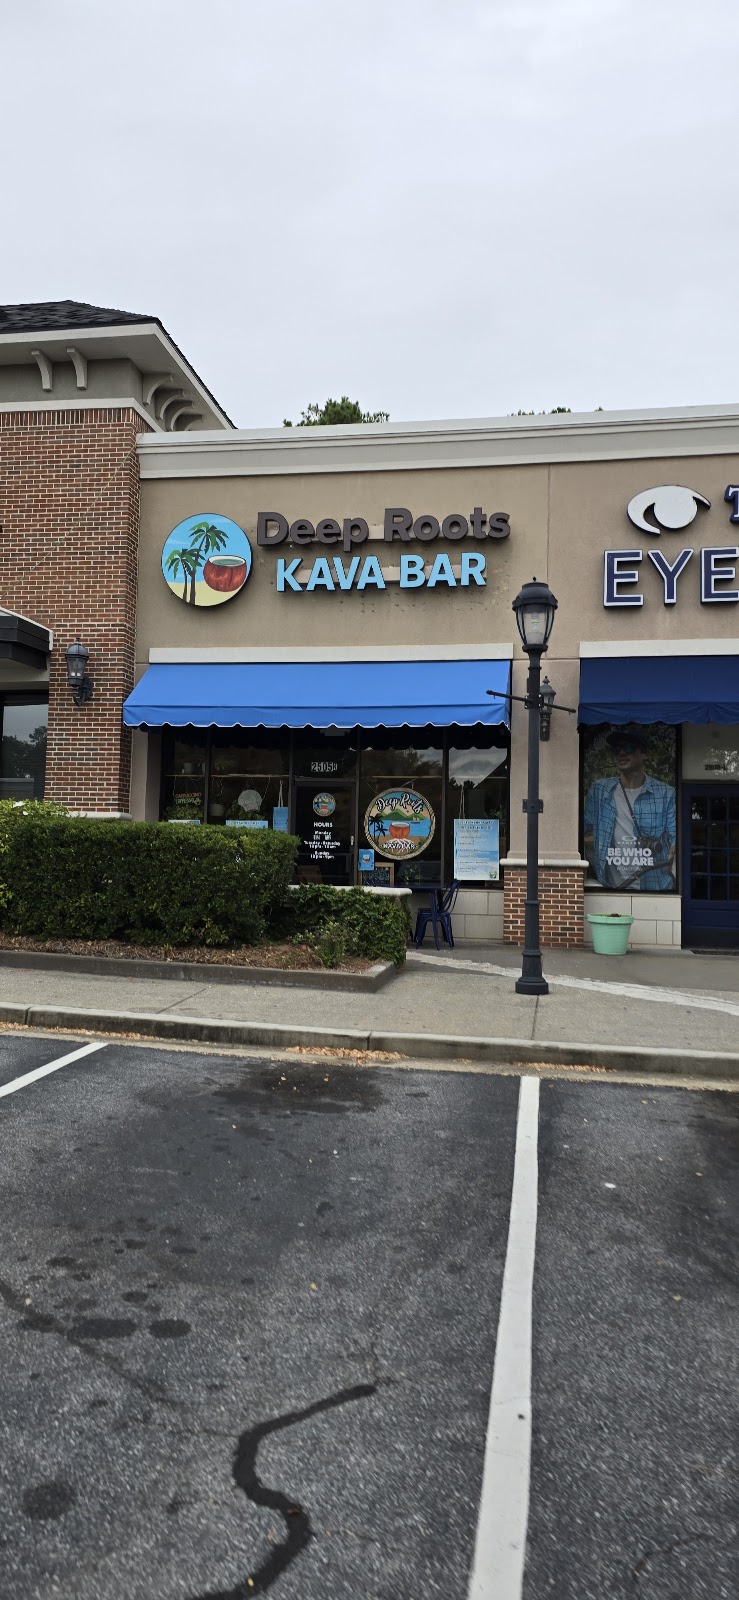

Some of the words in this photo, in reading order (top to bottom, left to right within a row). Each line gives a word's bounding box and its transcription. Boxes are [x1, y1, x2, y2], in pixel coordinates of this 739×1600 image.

[257, 512, 369, 551] Deep
[384, 507, 510, 542] Roots
[276, 555, 386, 592] KAVA
[400, 552, 487, 588] BAR
[376, 797, 398, 811] Deep
[400, 793, 423, 813] Roots
[606, 856, 630, 866] YOU
[631, 856, 654, 866] ARE
[607, 847, 621, 857] BE
[623, 847, 652, 857] WHO
